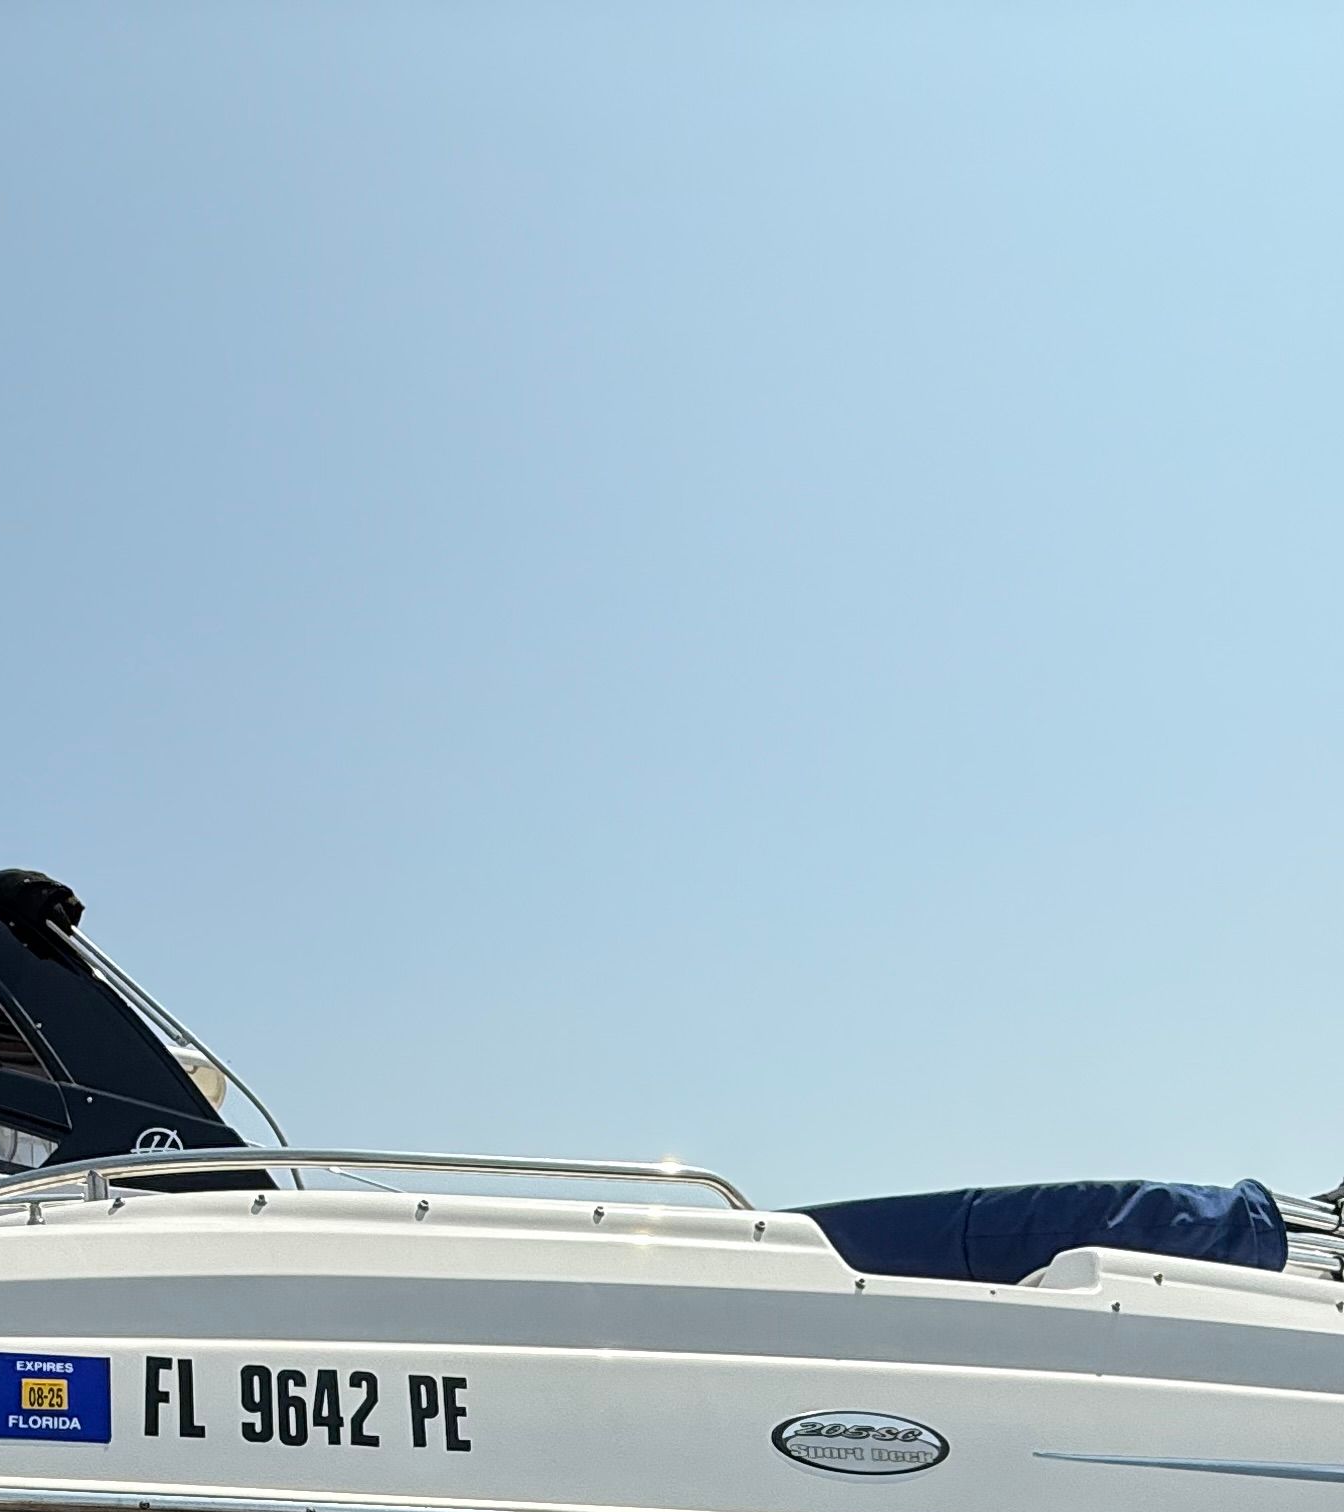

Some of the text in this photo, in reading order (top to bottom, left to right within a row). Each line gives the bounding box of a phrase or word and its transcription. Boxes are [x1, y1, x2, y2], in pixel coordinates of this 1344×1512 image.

[16, 1360, 74, 1373] EXPIRES
[28, 1386, 64, 1409] 08-25
[144, 1355, 471, 1452] FL 9642 PE
[8, 1415, 81, 1430] FLORIDA
[789, 1444, 936, 1464] Sport Deck
